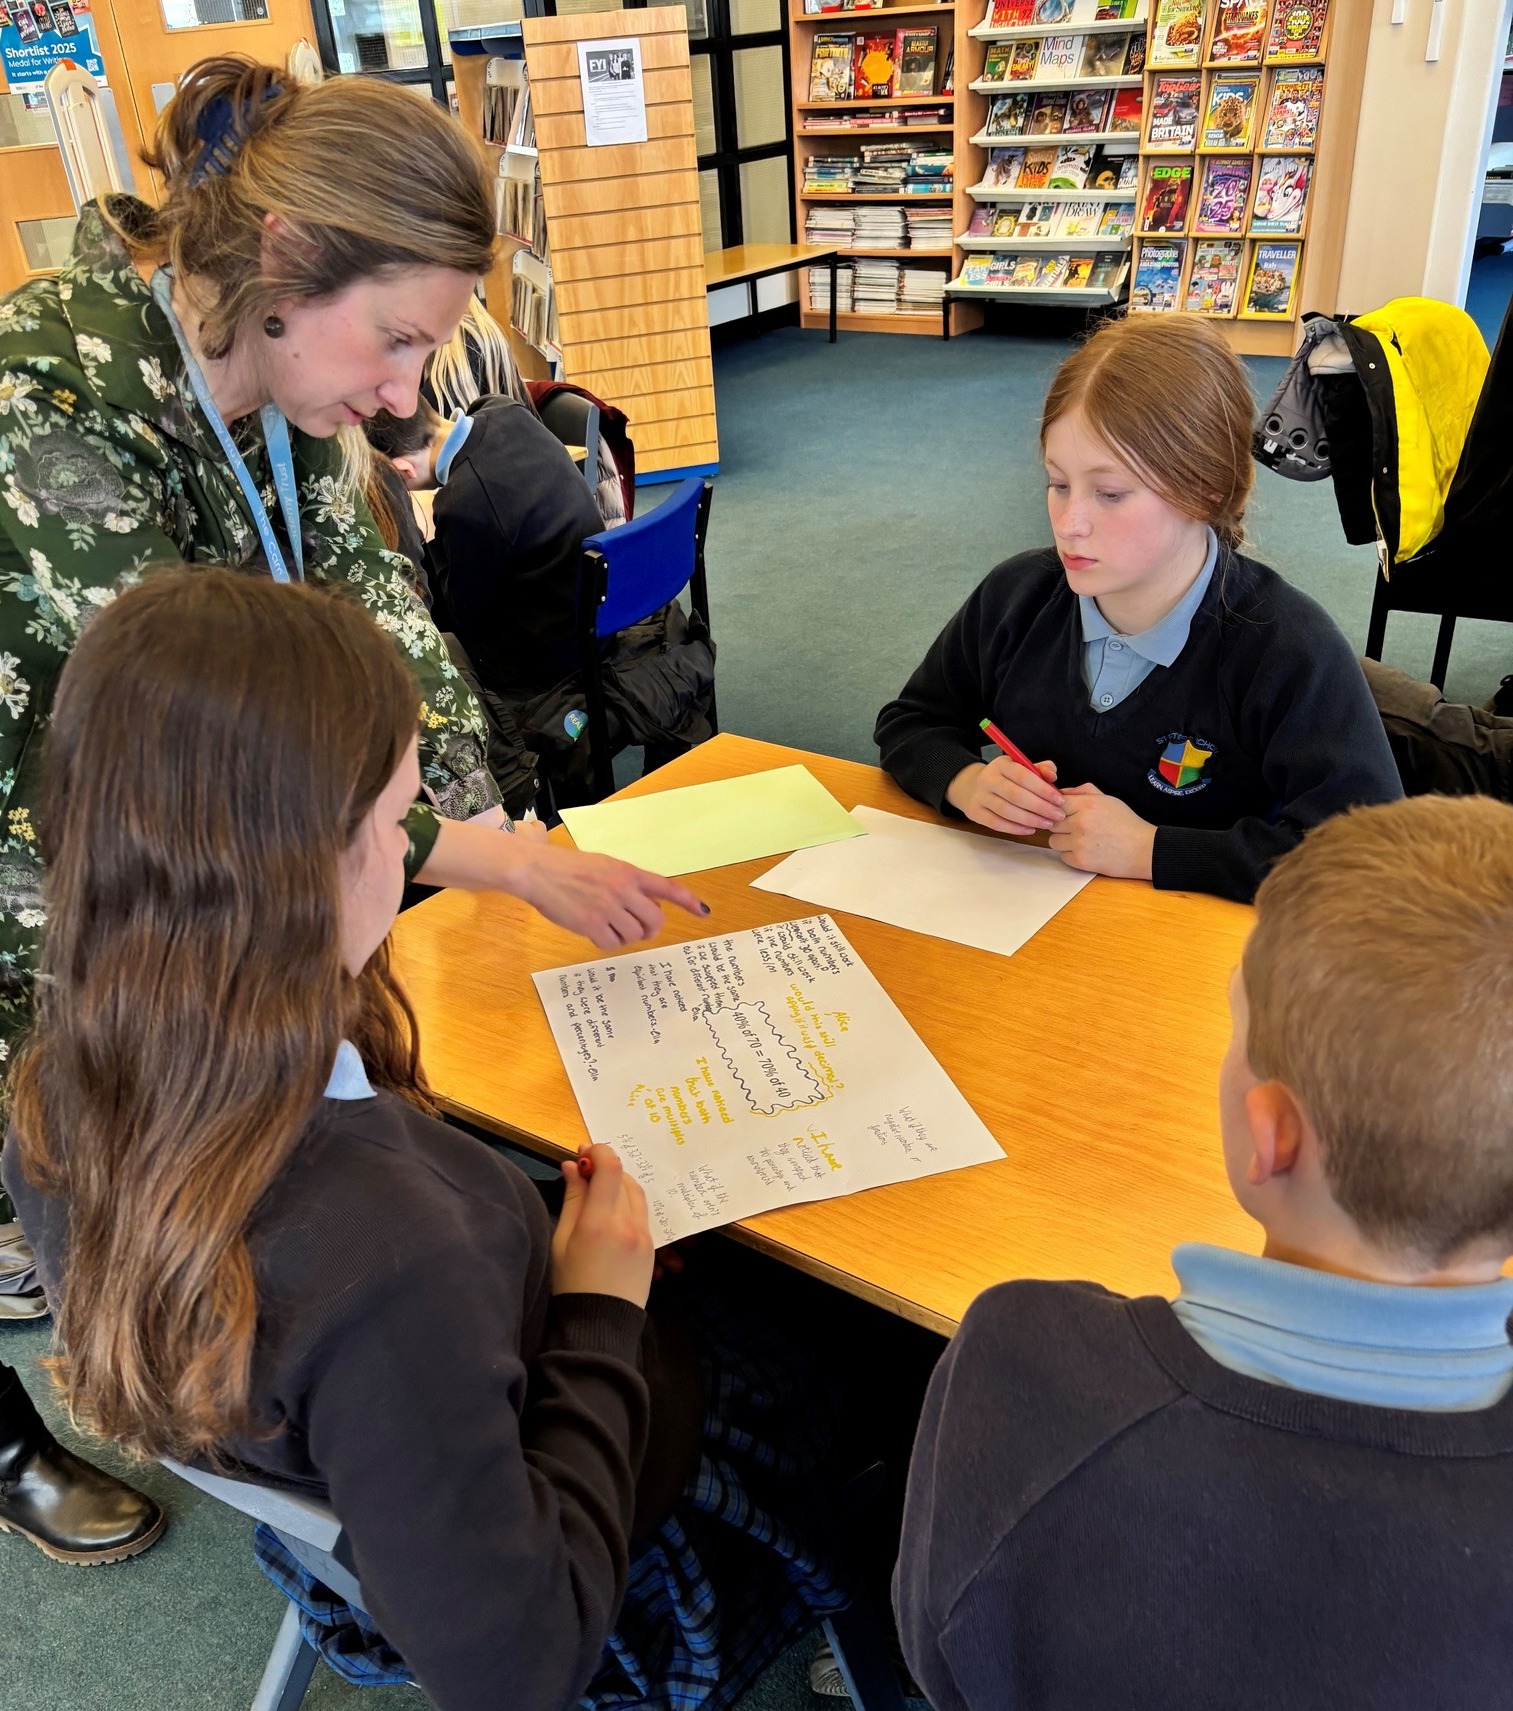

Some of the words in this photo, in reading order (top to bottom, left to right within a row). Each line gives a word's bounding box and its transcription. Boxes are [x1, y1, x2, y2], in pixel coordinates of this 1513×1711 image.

[993, 9, 1020, 20] WITH
[5, 45, 49, 58] Shortlist
[50, 43, 77, 55] 2025
[1043, 36, 1073, 51] Mind
[8, 60, 30, 68] Medal
[31, 59, 42, 67] for
[590, 59, 607, 72] FYI
[1040, 52, 1075, 68] Maps
[1158, 80, 1201, 92] TopGear
[1212, 91, 1245, 107] KIDS
[1152, 116, 1173, 126] MADE
[1151, 124, 1194, 139] BRITAIN
[1152, 166, 1191, 179] EDGE
[1215, 181, 1237, 198] 20
[1066, 206, 1098, 217] DRAW
[1208, 201, 1234, 220] 25
[1258, 249, 1296, 259] TRAVELLER
[990, 261, 1016, 271] GIRLS
[275, 462, 292, 494] Trust
[257, 508, 270, 537] The
[1147, 774, 1163, 792] LEARN
[751, 929, 763, 944] were
[723, 939, 733, 952] the
[806, 927, 820, 944] both
[817, 946, 839, 974] numbers
[829, 940, 845, 952] still
[839, 952, 853, 966] work
[686, 955, 696, 965] for
[698, 951, 707, 960] we
[765, 935, 777, 947] the
[774, 948, 794, 976] numbers
[777, 931, 792, 950] would
[786, 953, 802, 965] still
[797, 966, 815, 983] work
[586, 967, 598, 983] would
[648, 963, 657, 976] that
[708, 942, 722, 961] would
[715, 963, 725, 972] be
[721, 973, 731, 984] the
[726, 985, 739, 1002] same
[727, 955, 744, 986] numbers
[558, 974, 575, 998] numbers
[650, 980, 662, 997] they
[663, 969, 676, 986] have
[672, 989, 687, 1012] noticed
[595, 993, 604, 1003] be
[658, 997, 667, 1008] are
[566, 1003, 578, 1018] and
[568, 980, 584, 995] they
[580, 996, 590, 1014] were
[586, 1018, 604, 1047] different
[598, 1004, 608, 1016] the
[786, 996, 800, 1018] apply
[732, 1011, 750, 1029] 40%
[789, 983, 814, 1011] would
[810, 1013, 822, 1029] this
[819, 1031, 835, 1047] still
[831, 1011, 849, 1032] Alice
[601, 1019, 613, 1038] same
[741, 1029, 756, 1037] of
[747, 1034, 762, 1048] 70
[695, 1056, 707, 1064] I
[758, 1057, 777, 1077] 70%
[700, 1065, 713, 1086] have
[769, 1077, 784, 1086] of
[655, 1087, 666, 1102] are
[684, 1076, 700, 1096] that
[695, 1100, 710, 1123] both
[775, 1087, 790, 1097] 40
[643, 1098, 656, 1109] of
[712, 1090, 734, 1123] noticed
[649, 1111, 661, 1123] 10
[817, 1143, 841, 1171] have
[698, 1164, 715, 1183] What
